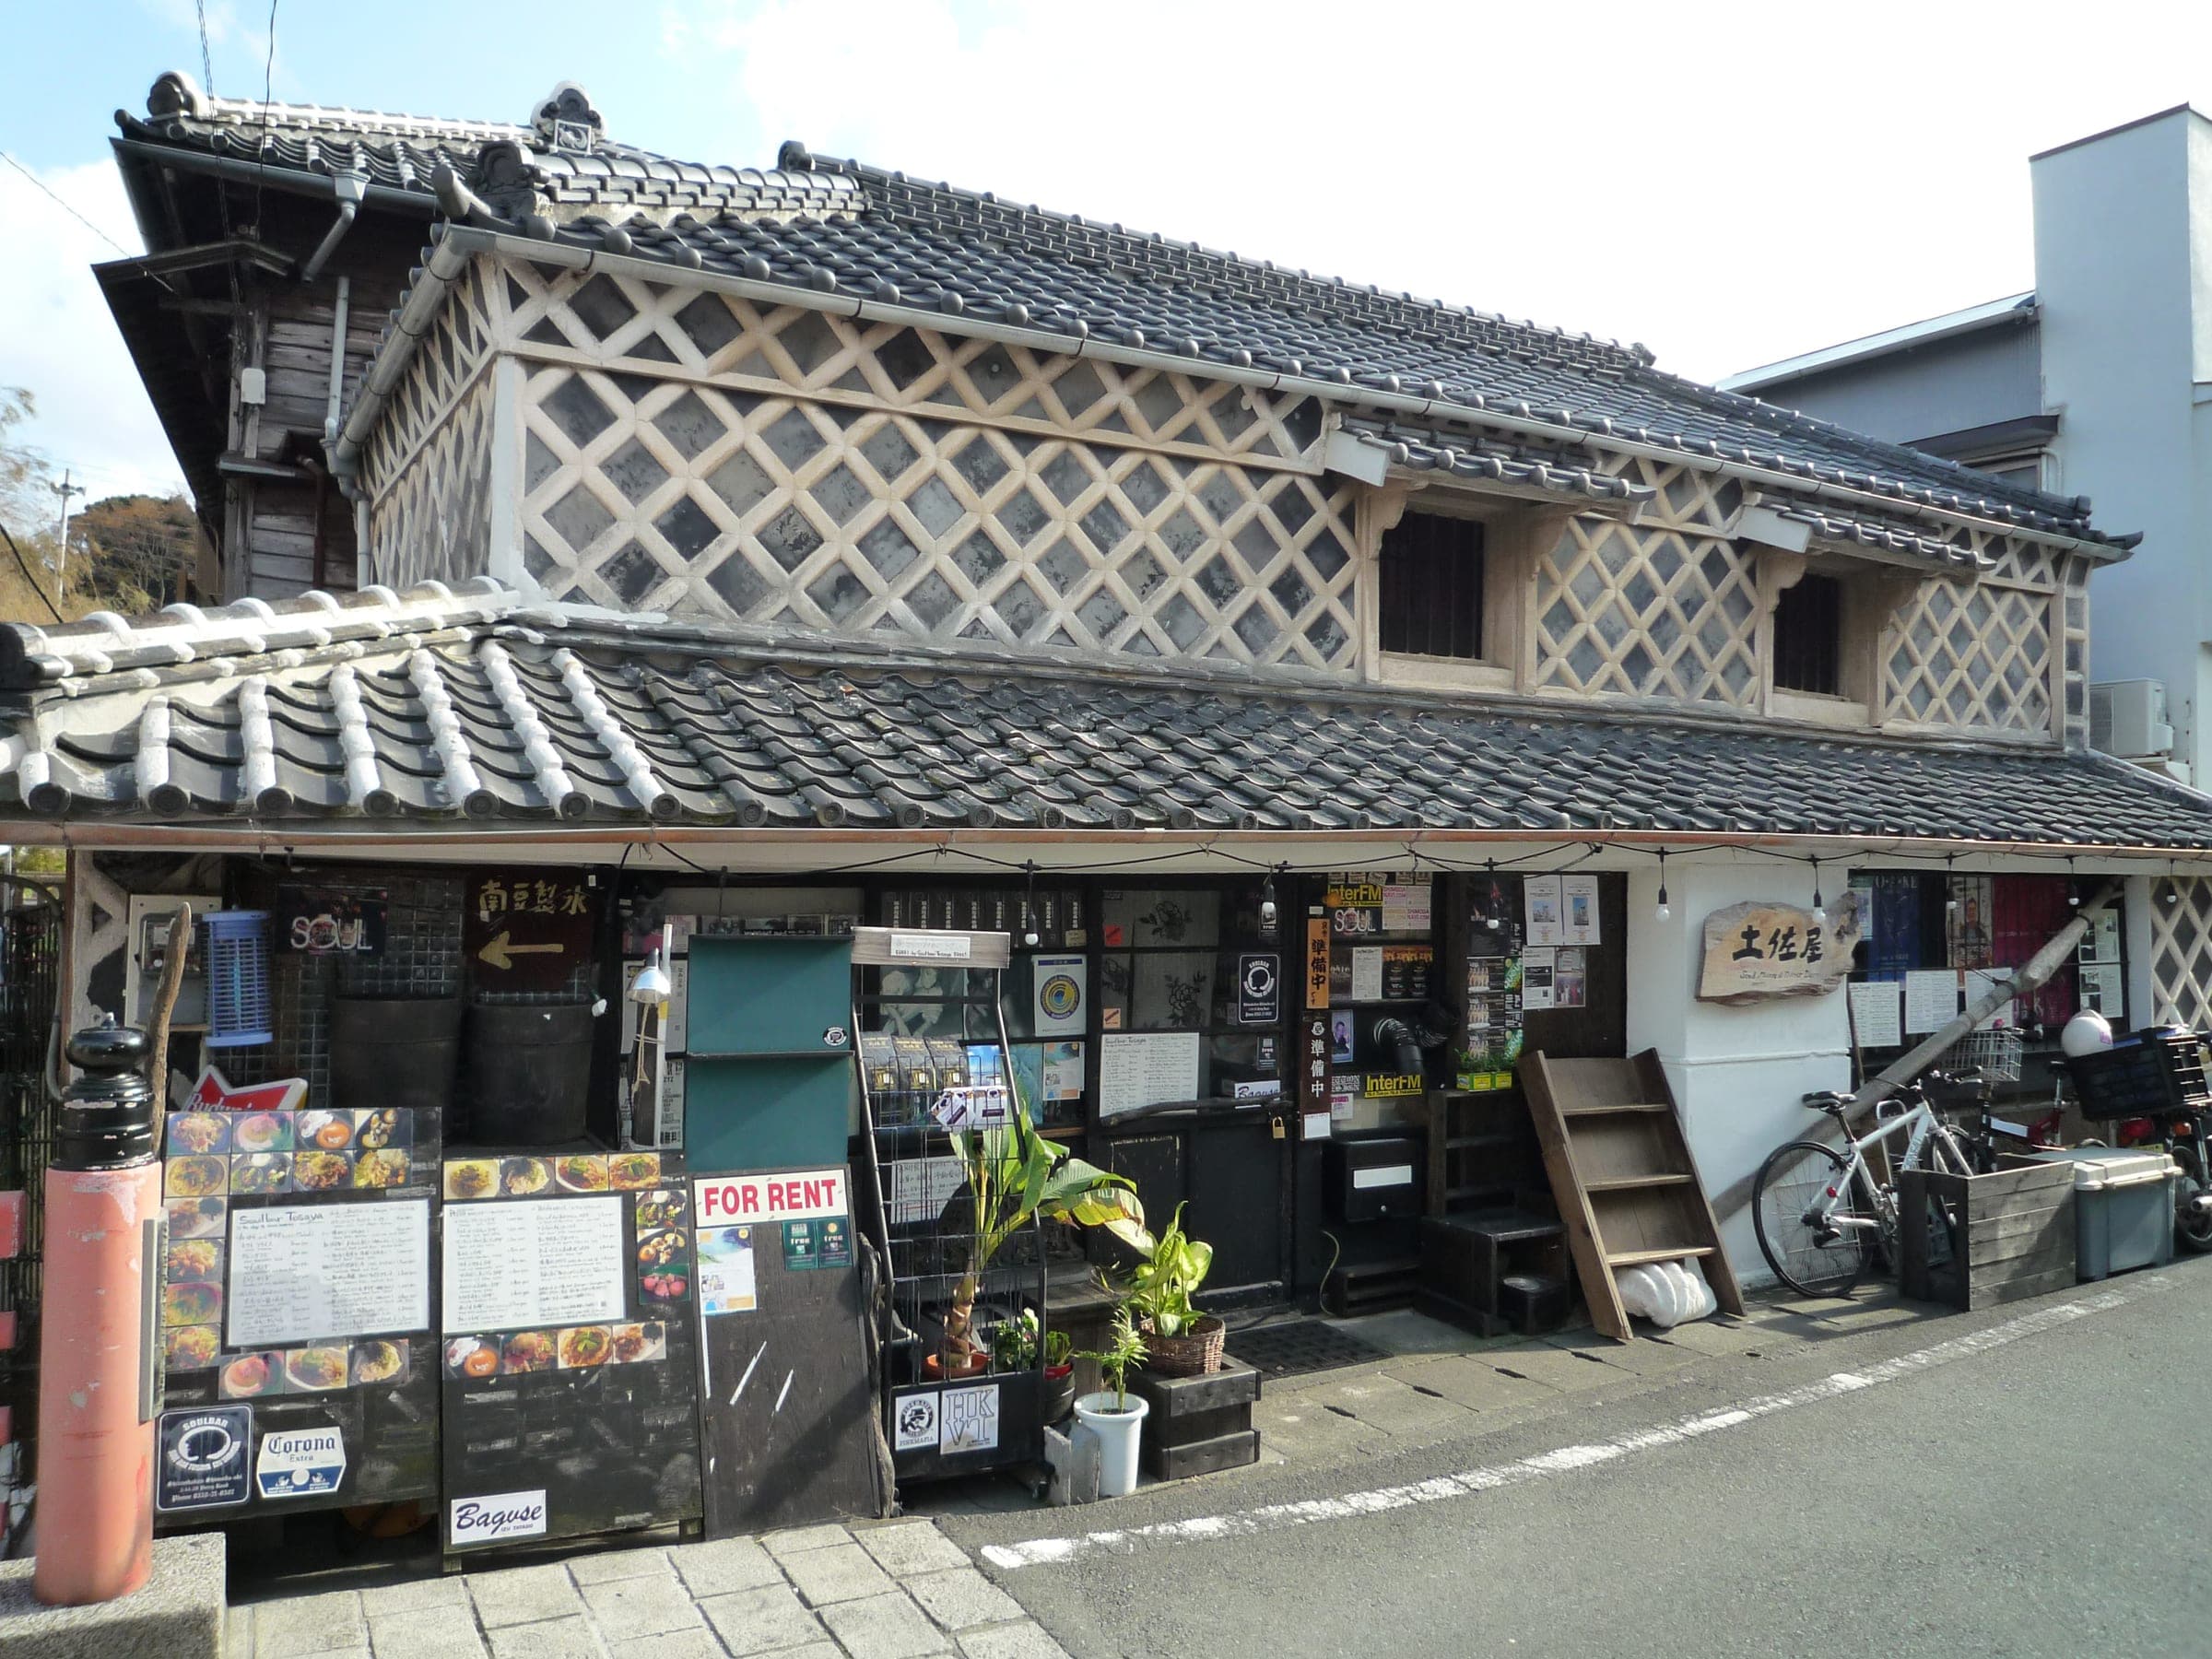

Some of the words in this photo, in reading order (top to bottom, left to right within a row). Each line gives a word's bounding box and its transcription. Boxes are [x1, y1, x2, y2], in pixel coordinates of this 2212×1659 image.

[290, 915, 372, 950] SOUL
[1335, 908, 1376, 932] SOUL
[1733, 924, 1823, 963] 土佐屋
[1312, 939, 1327, 990] 準備中
[1311, 1040, 1324, 1098] 準備中
[1366, 1075, 1421, 1091] InterFM
[704, 1185, 759, 1216] FOR
[768, 1179, 836, 1211] RENT
[182, 1417, 229, 1430] SOULBAR
[267, 1435, 335, 1457] Corona
[289, 1453, 314, 1464] Extra
[456, 1502, 542, 1535] Baguse
